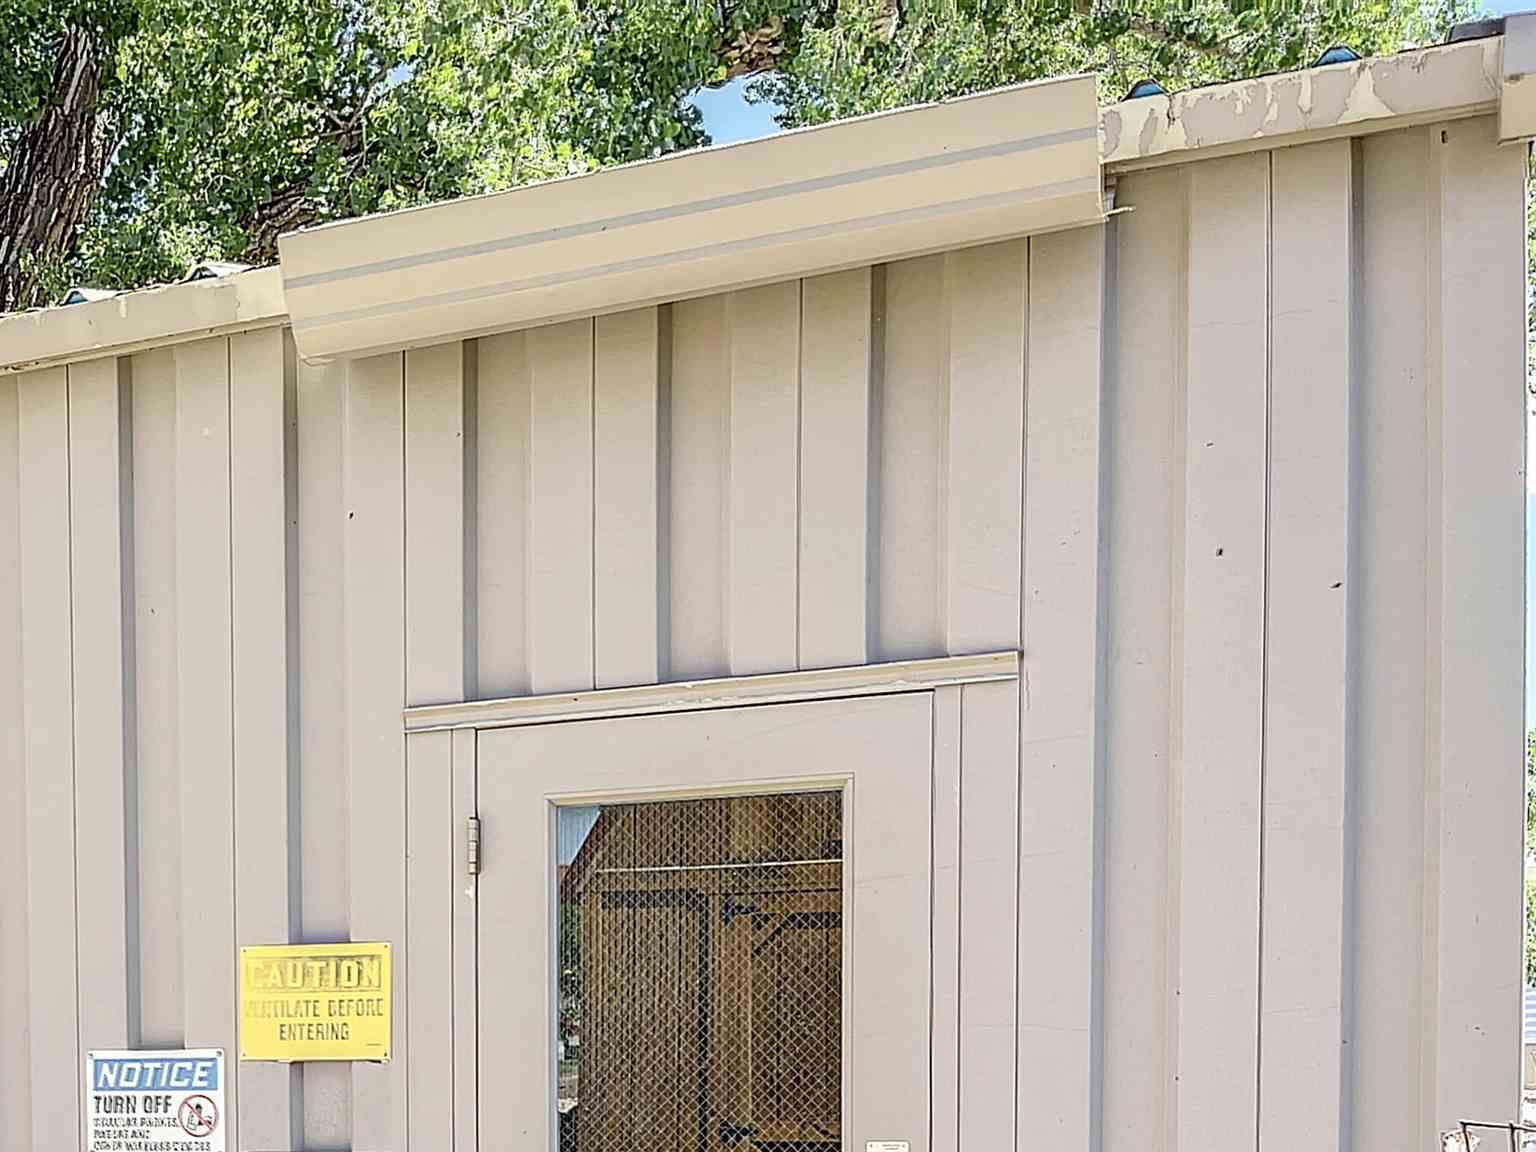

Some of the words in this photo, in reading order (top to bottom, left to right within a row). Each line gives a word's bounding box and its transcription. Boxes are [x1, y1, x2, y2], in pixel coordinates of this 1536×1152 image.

[246, 957, 383, 990] CAUTION
[328, 998, 384, 1017] BEFORE
[279, 1022, 350, 1041] ENTERING
[96, 1061, 213, 1089] NOTICE
[94, 1096, 136, 1115] TURN
[144, 1095, 172, 1115] OFF
